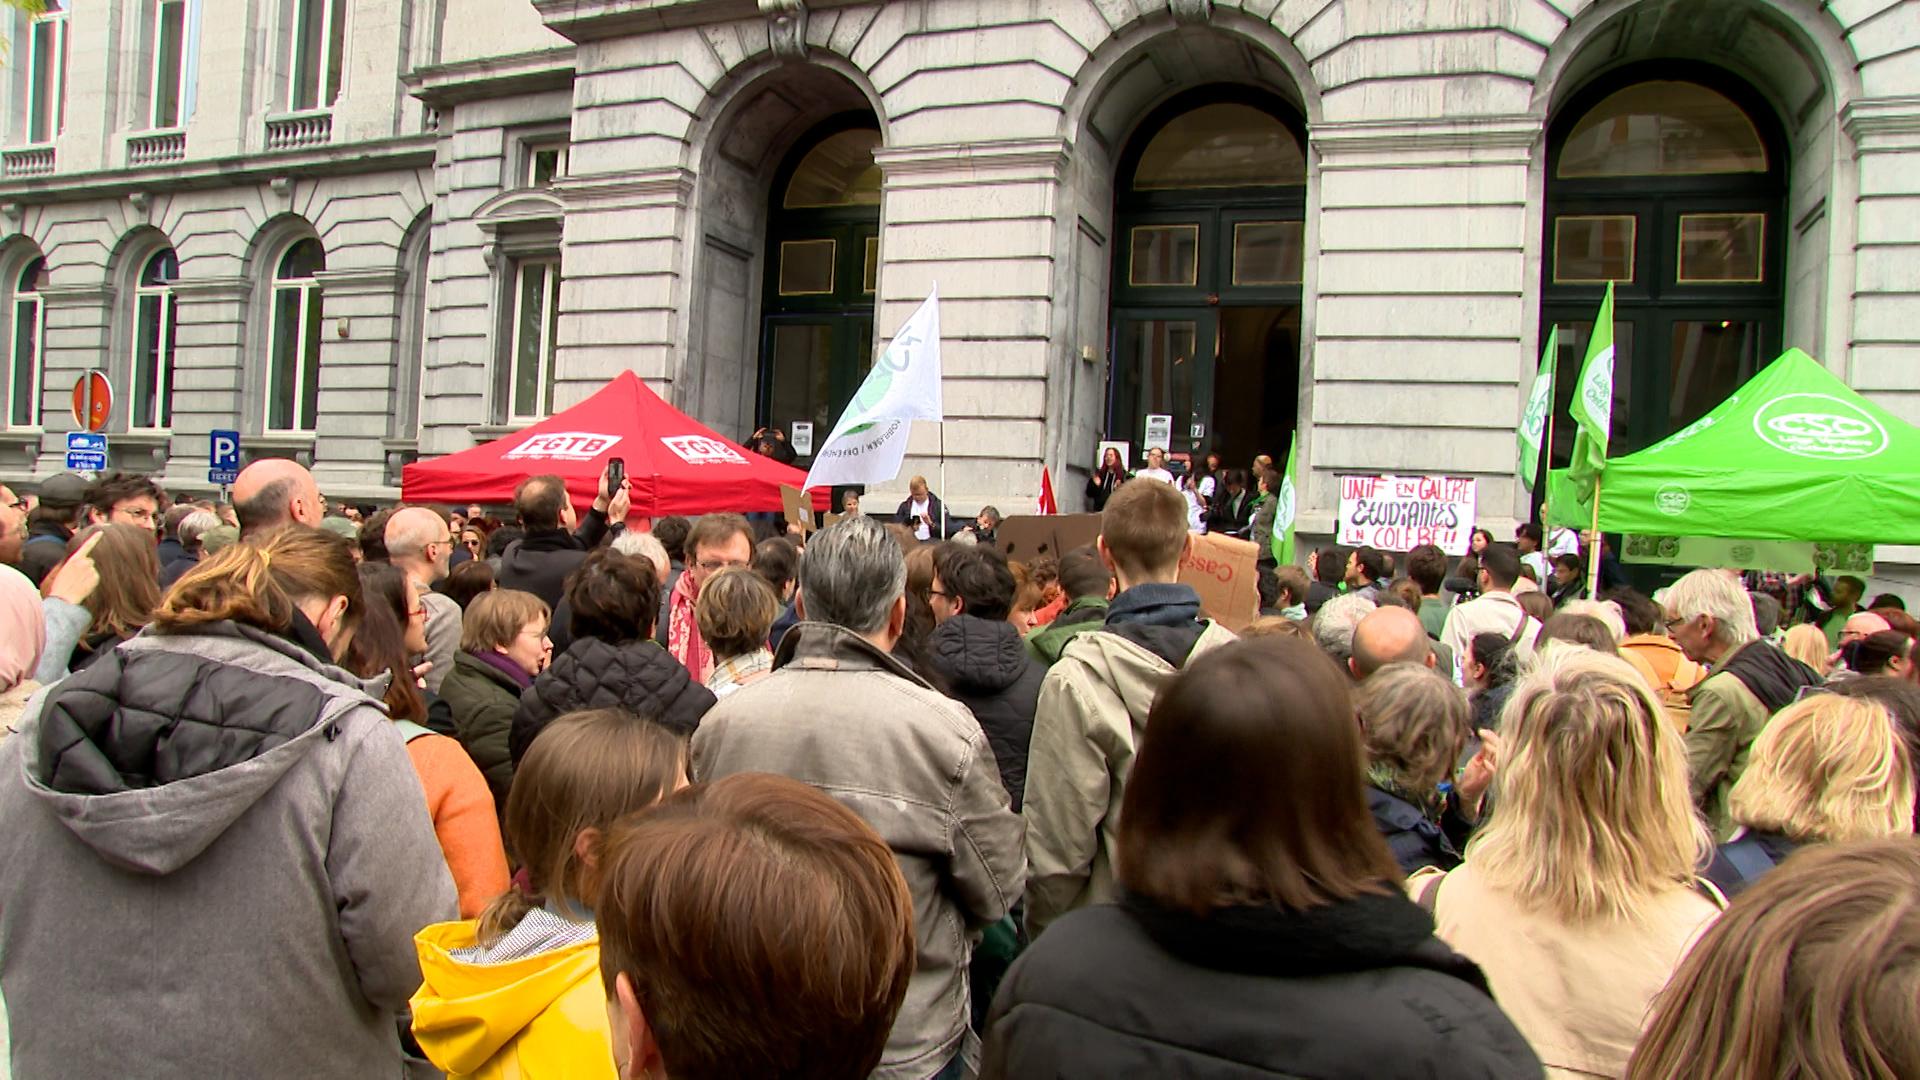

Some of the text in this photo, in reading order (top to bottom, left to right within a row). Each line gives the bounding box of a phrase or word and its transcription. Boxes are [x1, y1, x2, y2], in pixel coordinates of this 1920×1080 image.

[1767, 413, 1872, 437] CSC
[522, 437, 608, 452] FGTB
[1396, 483, 1414, 497] EN
[1346, 529, 1364, 541] EN
